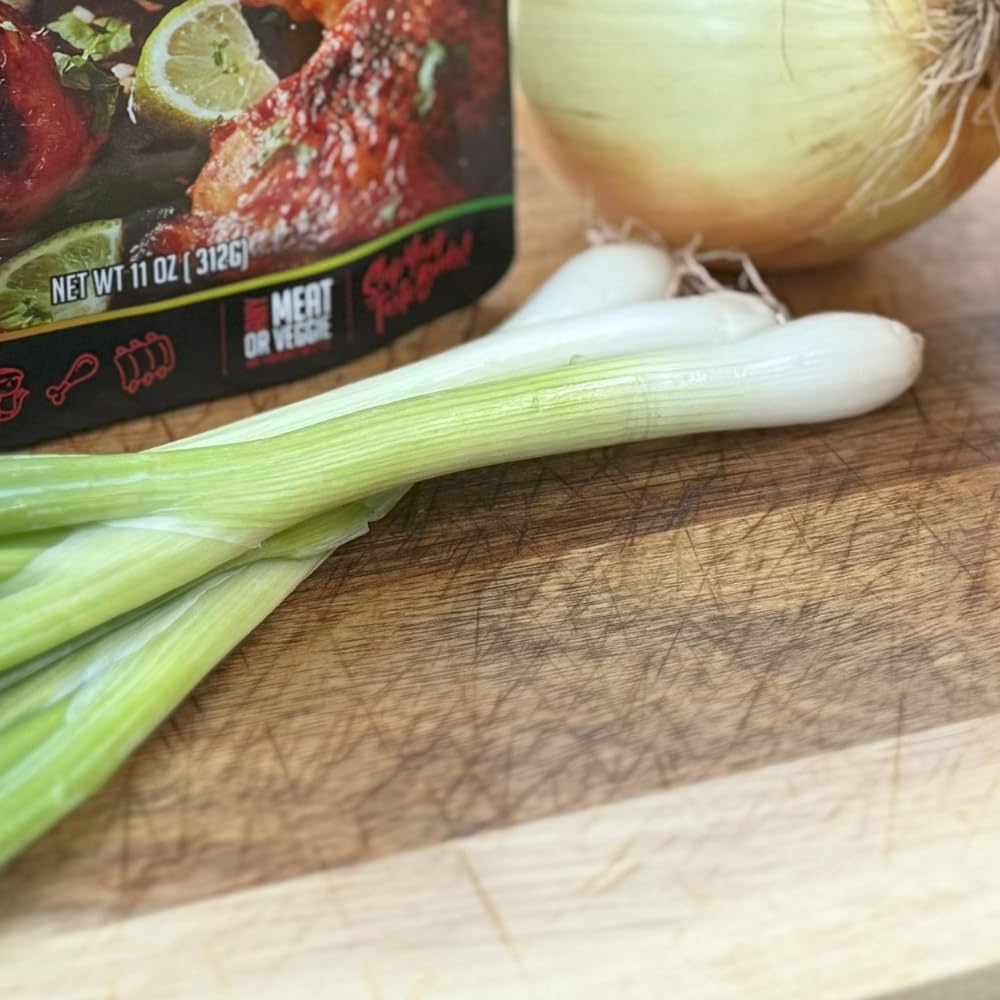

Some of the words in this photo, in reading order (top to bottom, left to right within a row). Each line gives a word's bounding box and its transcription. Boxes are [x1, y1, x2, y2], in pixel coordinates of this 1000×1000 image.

[52, 272, 88, 305] NET
[93, 264, 124, 296] WT
[130, 261, 148, 289] 11
[153, 254, 178, 284] OZ
[271, 278, 334, 328] MEAT
[244, 329, 270, 359] OR
